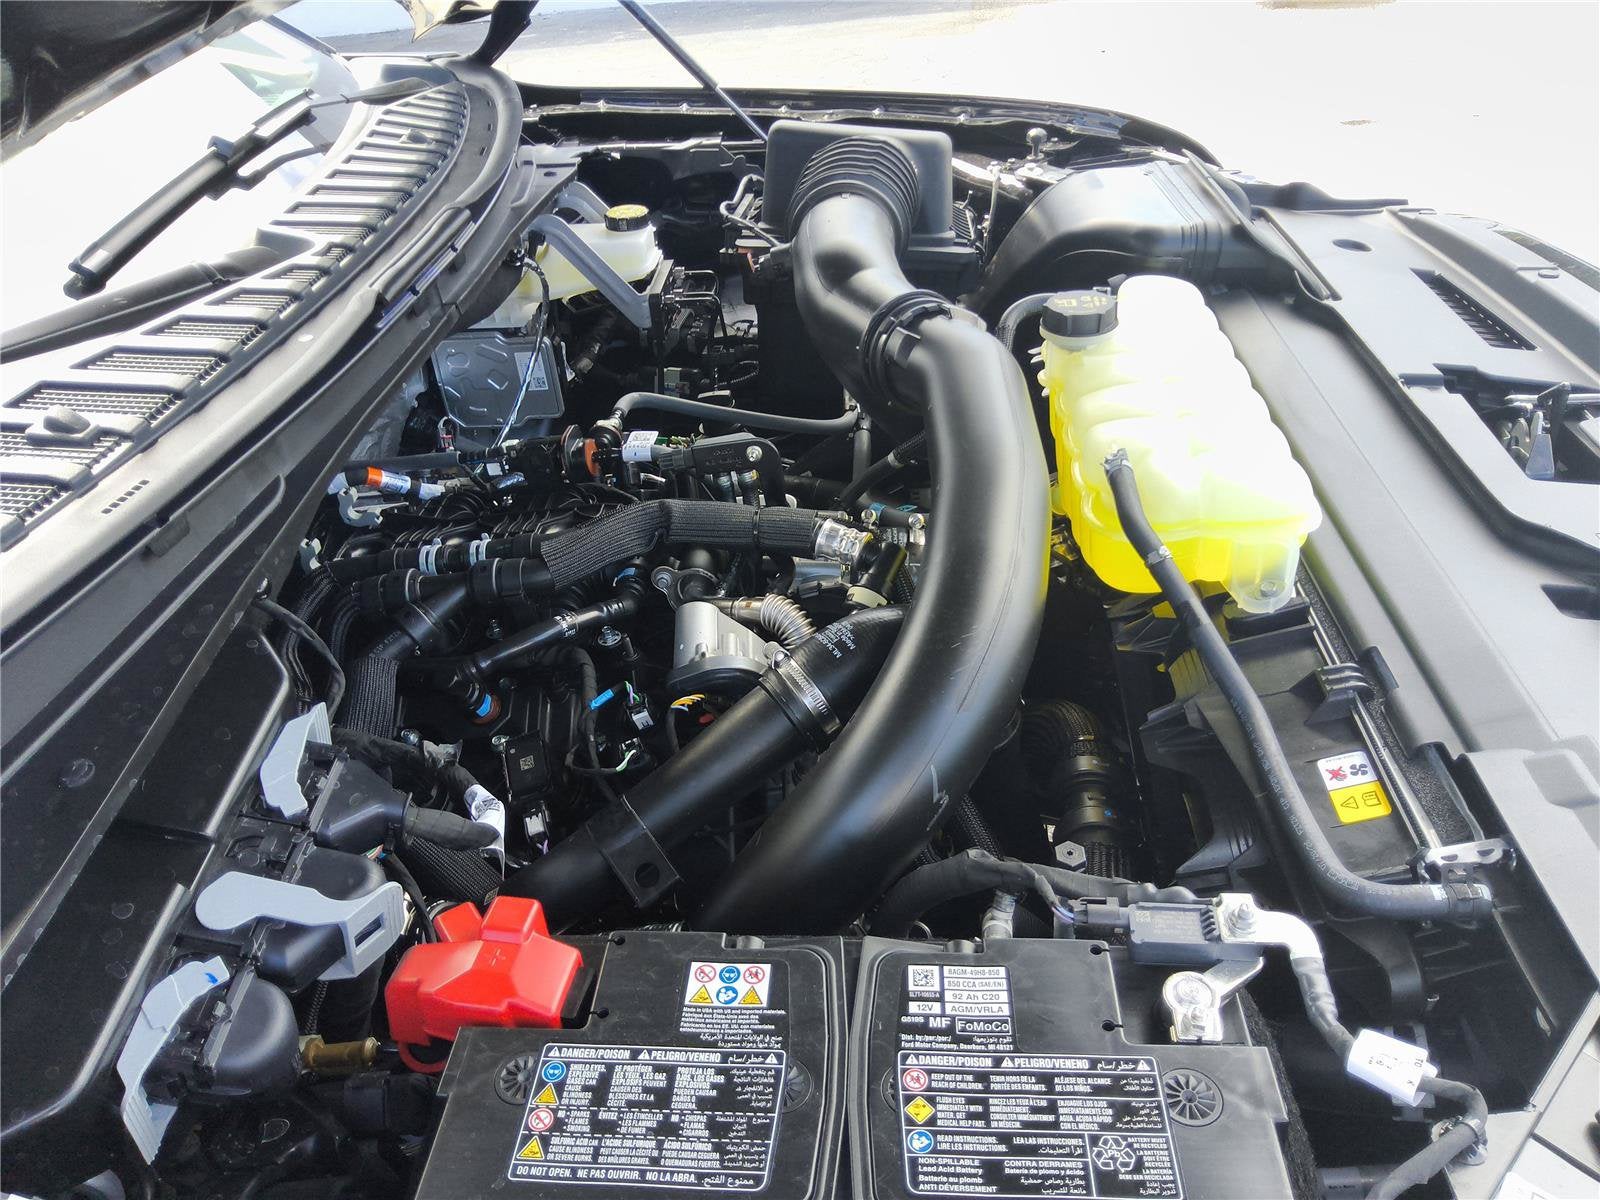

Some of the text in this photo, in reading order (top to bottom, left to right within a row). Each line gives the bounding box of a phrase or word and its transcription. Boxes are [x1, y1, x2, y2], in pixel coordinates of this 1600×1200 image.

[929, 1017, 951, 1028] MF
[958, 1021, 1009, 1031] FoMoCo
[560, 1047, 630, 1058] DANGER/POISON
[650, 1050, 721, 1061] PELIGRO/VENENO
[918, 1055, 992, 1066] DANGER/POISON
[1013, 1057, 1088, 1069] PELIGRO/VENENO
[611, 1078, 642, 1086] EXPLOSIFS
[588, 1138, 599, 1146] CAN
[937, 1142, 950, 1150] LIRE
[962, 1143, 1008, 1151] INSTRUCTIONS.
[1107, 1149, 1120, 1157] Pb
[918, 1157, 979, 1165] NON-SPILLABLE
[516, 1166, 698, 1183] DO NOT OPEN. NE PAS OUVRIR. NO LA ABRA.
[918, 1165, 983, 1175] Lead Acid Battery
[726, 1175, 754, 1189] ممنوع
[918, 1175, 983, 1184] Batterie au plomb
[938, 1183, 997, 1192] DÉVERSEMENT
